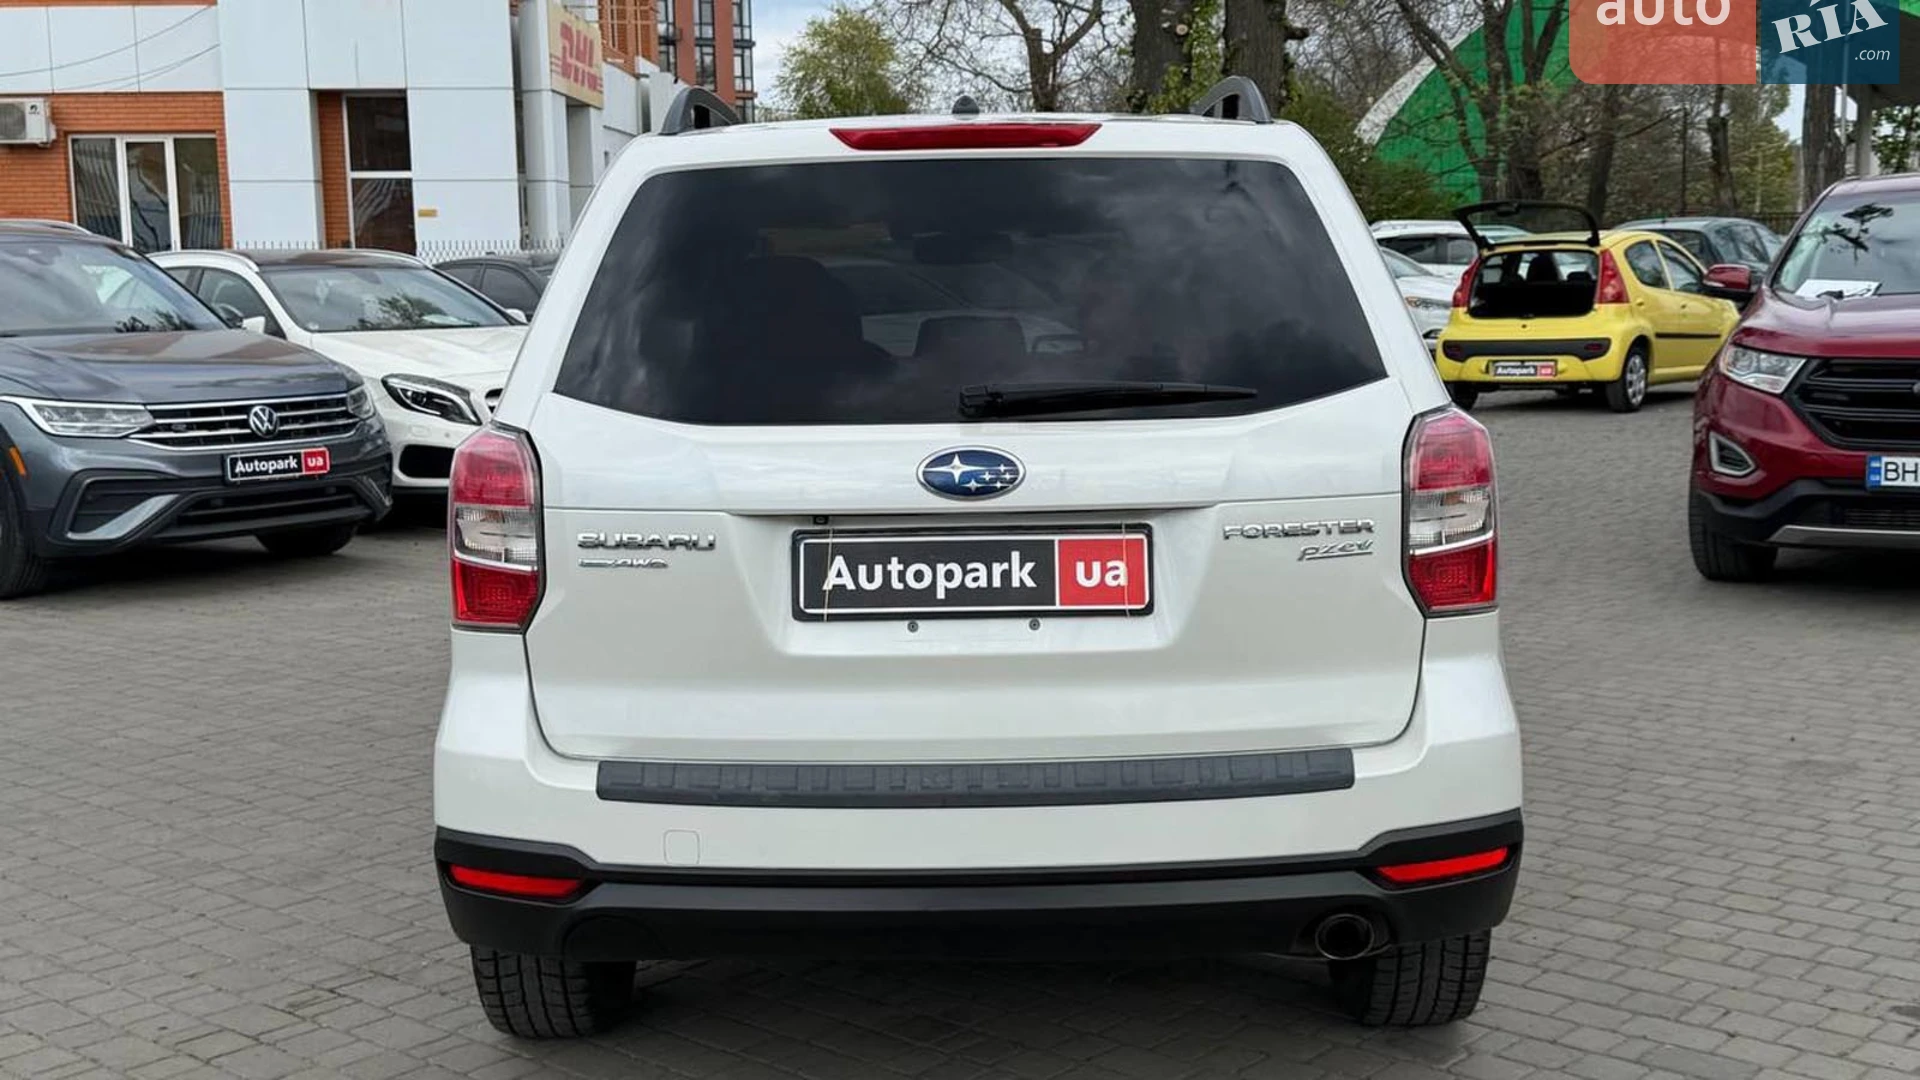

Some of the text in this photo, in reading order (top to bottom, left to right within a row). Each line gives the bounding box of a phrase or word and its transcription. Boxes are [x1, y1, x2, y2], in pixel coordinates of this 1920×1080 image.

[560, 21, 600, 91] DHL
[234, 455, 324, 474] Autopark ua
[1223, 519, 1375, 540] FORESTER
[577, 532, 716, 551] SUBARU
[822, 550, 1128, 600] Autopark ua
